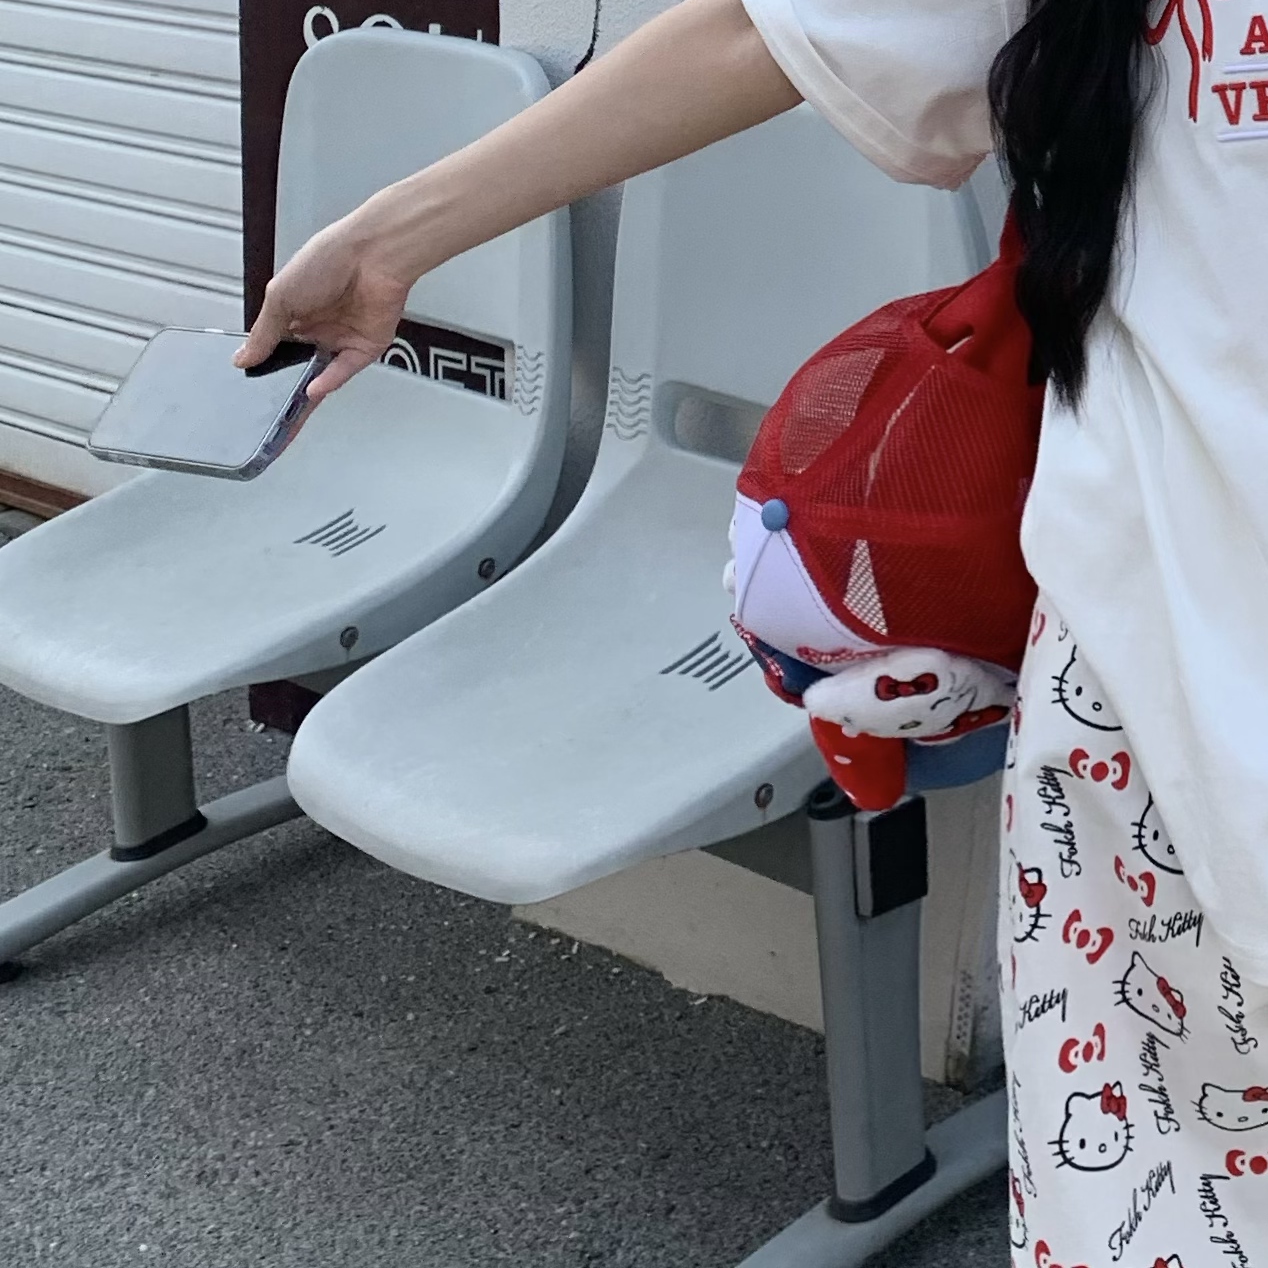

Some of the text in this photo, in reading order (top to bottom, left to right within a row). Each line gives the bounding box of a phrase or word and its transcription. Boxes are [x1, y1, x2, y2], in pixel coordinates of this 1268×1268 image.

[1036, 764, 1074, 817] Kitty
[1158, 909, 1204, 948] Kitty
[1018, 987, 1068, 1029] Kitty
[1139, 1031, 1171, 1082] Kitty
[1197, 1173, 1231, 1228] Kitty
